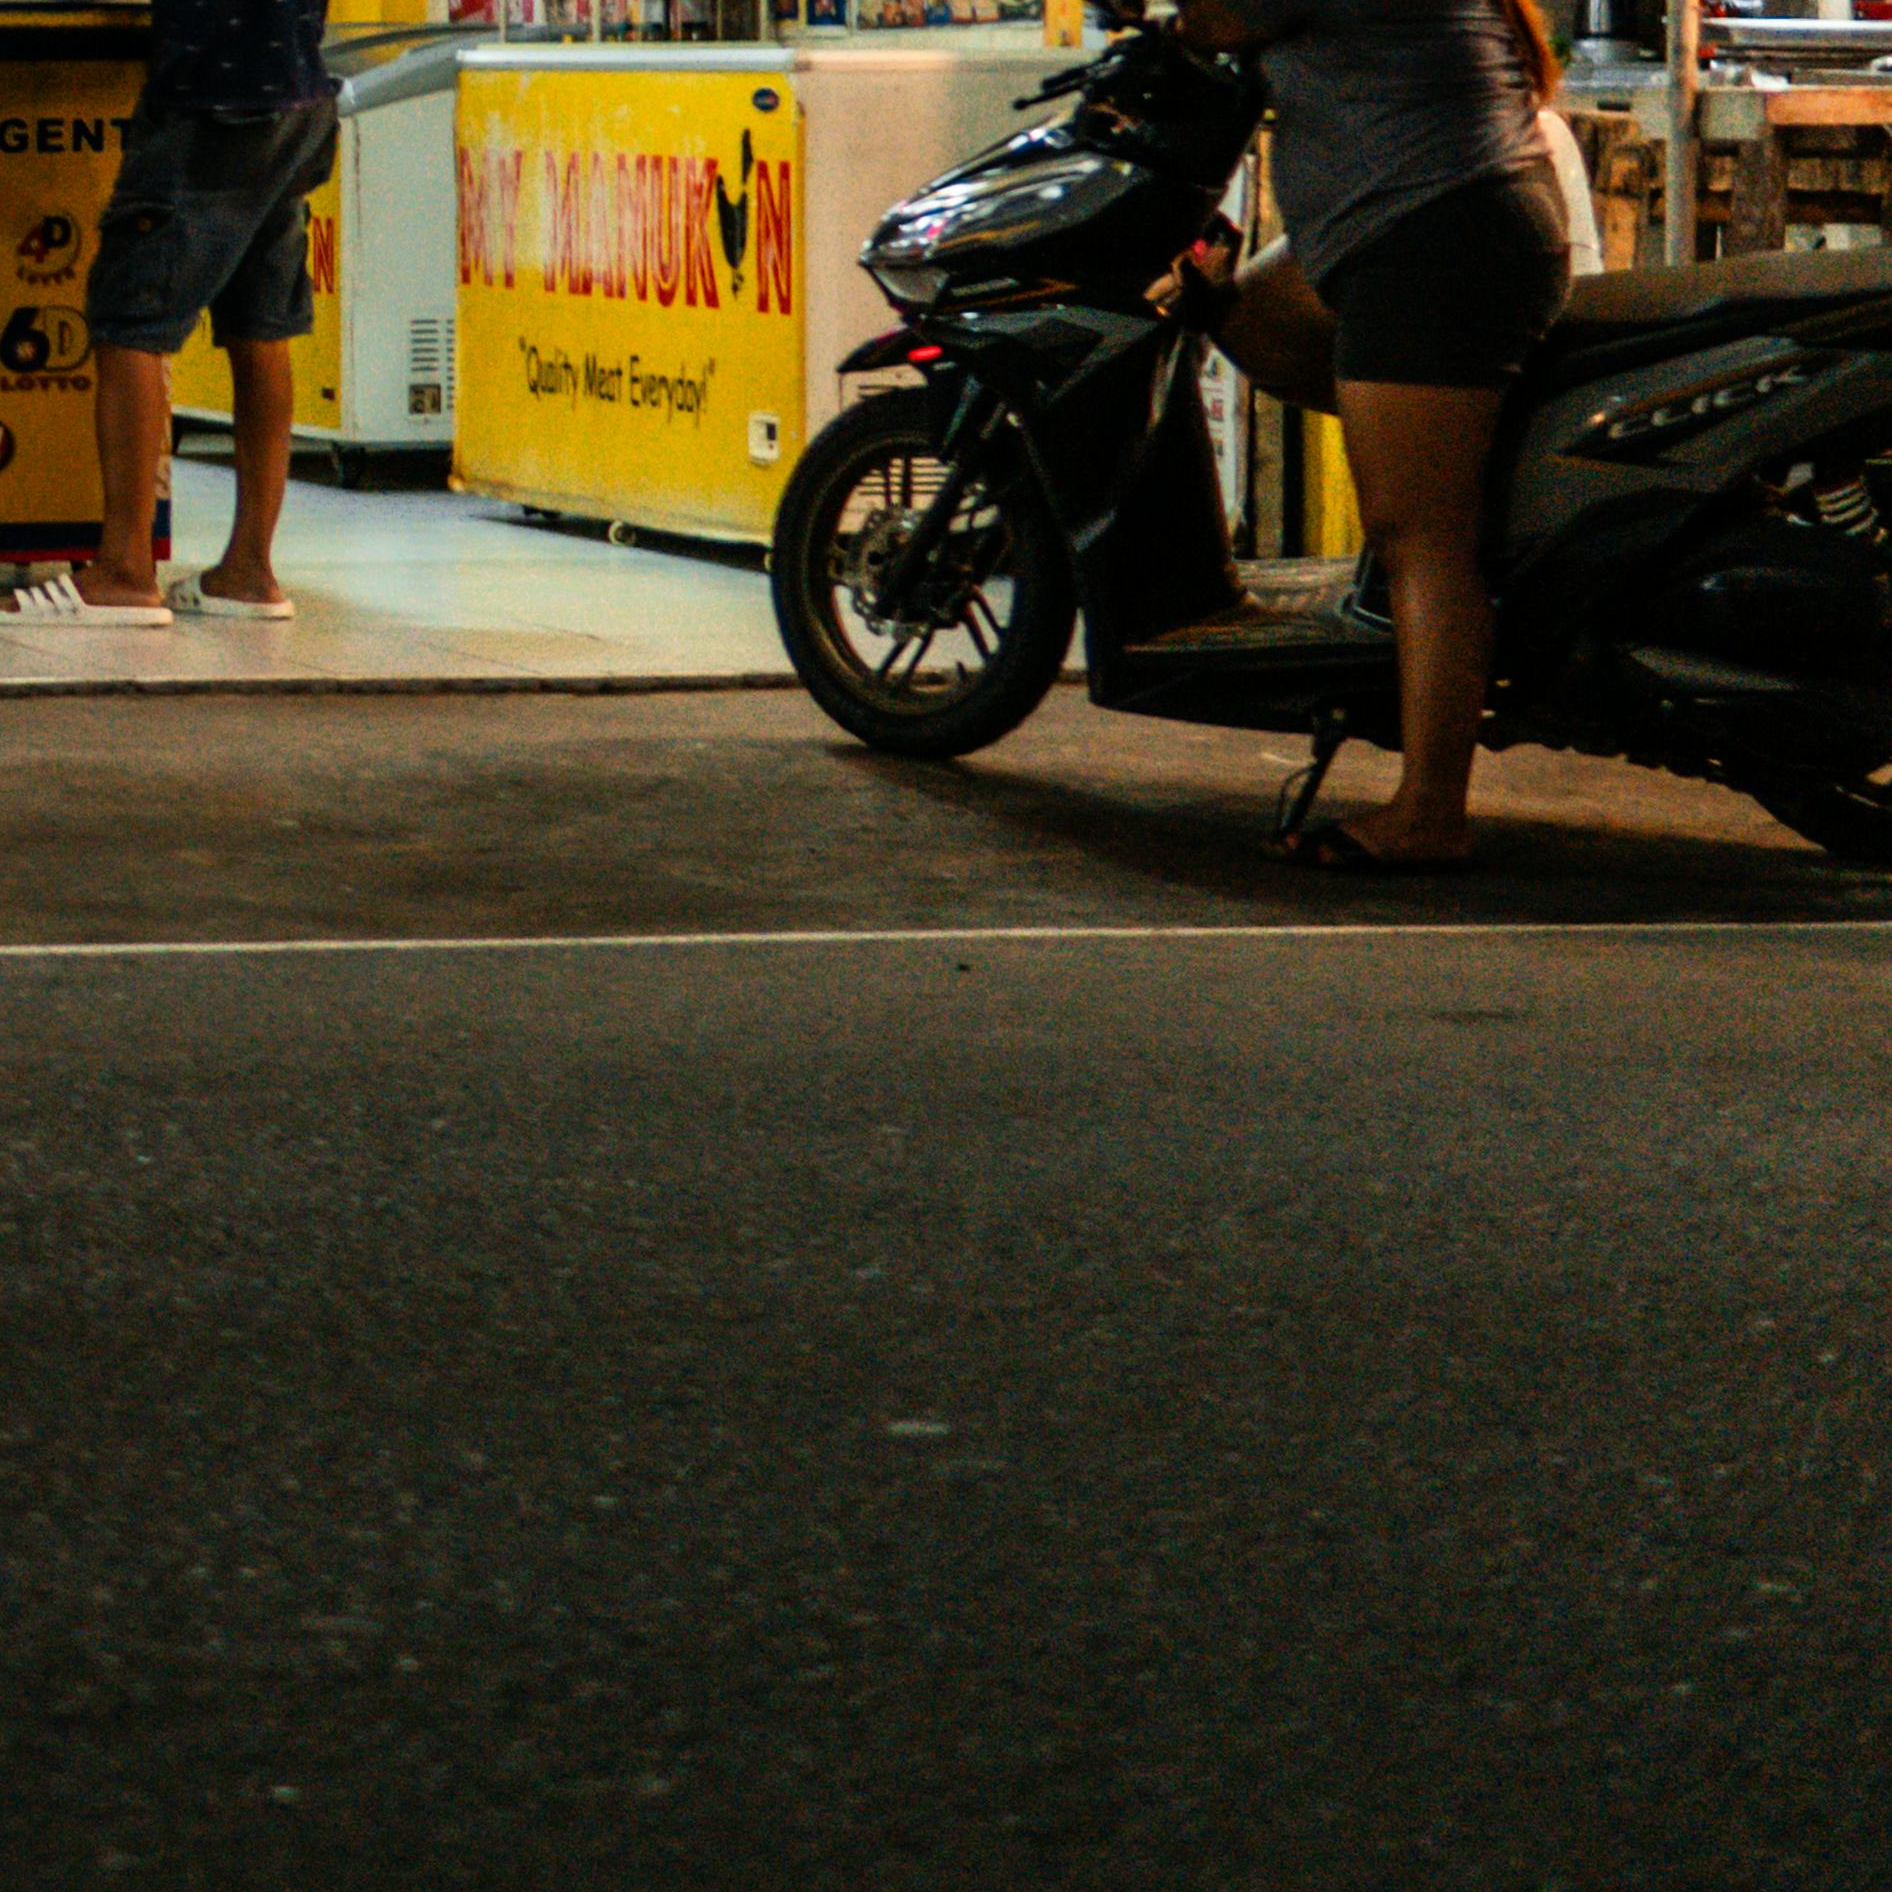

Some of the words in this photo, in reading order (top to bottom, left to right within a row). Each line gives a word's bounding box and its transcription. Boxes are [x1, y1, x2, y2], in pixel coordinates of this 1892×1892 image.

[0, 374, 92, 394] LOTTO
[583, 352, 623, 403] Meat
[1605, 364, 1813, 444] CLICK
